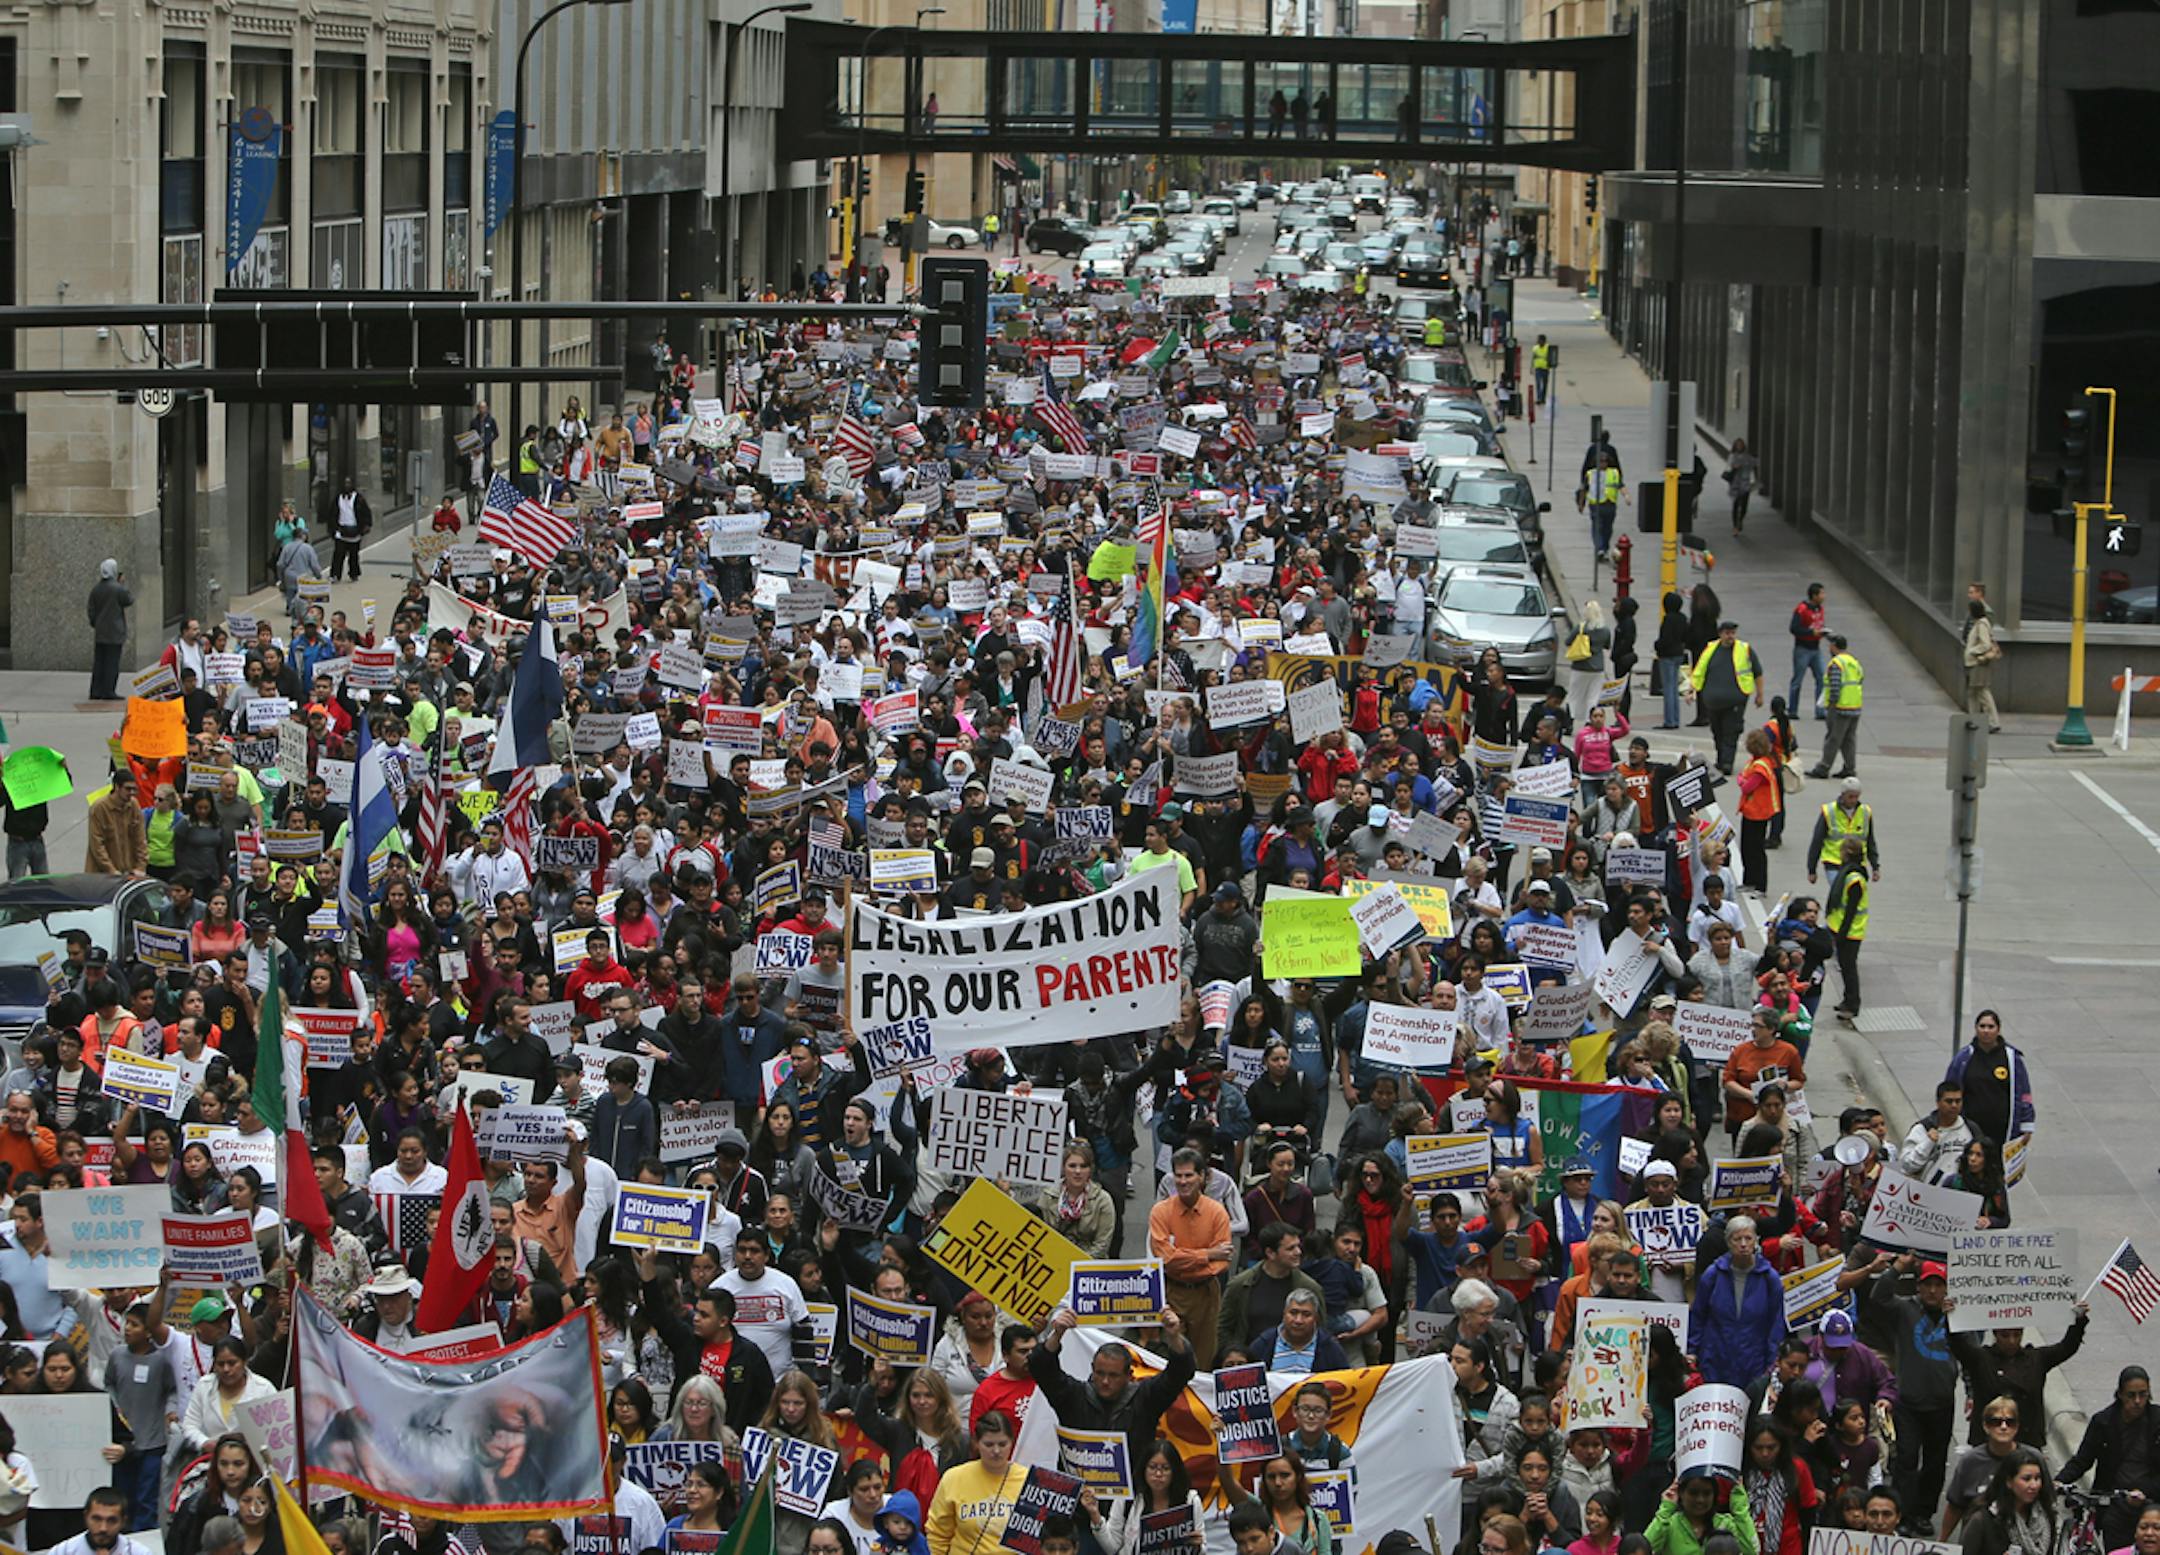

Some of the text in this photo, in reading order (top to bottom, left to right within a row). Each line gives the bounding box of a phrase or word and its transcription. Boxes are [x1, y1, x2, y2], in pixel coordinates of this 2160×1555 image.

[1213, 706, 1265, 720] Americano
[1004, 781, 1017, 794] un
[1638, 786, 1647, 798] 3
[1057, 808, 1110, 821] TIME IS
[1059, 820, 1110, 837] NOW
[544, 840, 596, 850] TIME IS
[544, 850, 598, 866] NOW
[812, 844, 862, 866] TIME IS
[1620, 859, 1640, 867] YES
[810, 856, 864, 880] NOW
[852, 885, 1163, 956] LEGALIZATION
[760, 936, 811, 951] TIME IS
[1523, 936, 1577, 952] migratoria
[757, 949, 810, 968] NOW
[1530, 948, 1565, 960] ahora!
[861, 944, 1181, 1022] FOR OUR PARENTS
[1372, 1010, 1454, 1034] Citizenship is
[1534, 1008, 1567, 1018] es un
[316, 1020, 354, 1031] FAMILIES
[863, 1017, 930, 1047] TIME IS
[1680, 1024, 1749, 1042] es un valor
[1368, 1037, 1402, 1054] value
[1370, 1026, 1448, 1046] an American
[868, 1031, 932, 1070] NOW
[504, 1112, 545, 1122] America
[664, 1110, 729, 1124] iudadanía
[938, 1090, 1064, 1130] LIBERTY
[1524, 1102, 1534, 1114] is
[516, 1122, 556, 1136] YES to
[674, 1118, 728, 1135] un valor
[936, 1116, 1060, 1156] JUSTICE
[660, 1134, 720, 1150] American
[934, 1144, 1056, 1182] FOR ALL
[1721, 1168, 1774, 1186] Citizenship
[86, 1194, 126, 1216] WE
[624, 1198, 693, 1223] Citizenship
[1888, 1200, 1952, 1225] CAMPAIGN
[622, 1215, 693, 1238] for 11 million
[1624, 1207, 1700, 1230] TIME IS
[71, 1220, 144, 1242] WANT
[166, 1226, 246, 1242] UNITE FAMILIES
[1015, 1218, 1050, 1259] EL
[1952, 1234, 2055, 1250] LAND OF THE FREE
[65, 1246, 161, 1270] JUSTICE
[172, 1248, 243, 1259] Comprehensive
[221, 1256, 258, 1270] Reform
[1951, 1253, 2062, 1270] JUSTICE FOR ALL
[222, 1266, 260, 1282] NOW!
[1078, 1276, 1150, 1296] Citizenship
[1078, 1296, 1154, 1314] for 11 million
[854, 1304, 916, 1340] Citizenship
[854, 1320, 868, 1340] for
[878, 1335, 918, 1354] million
[1584, 1326, 1649, 1357] Want
[1216, 1385, 1269, 1410] JUSTICE
[1220, 1416, 1276, 1442] DIGNITY
[625, 1442, 722, 1467] TIME IS
[809, 1446, 834, 1474] IS
[1019, 1483, 1076, 1517] JUSTICE
[1007, 1512, 1044, 1540] DIGN
[1142, 1520, 1194, 1546] JUSTICE
